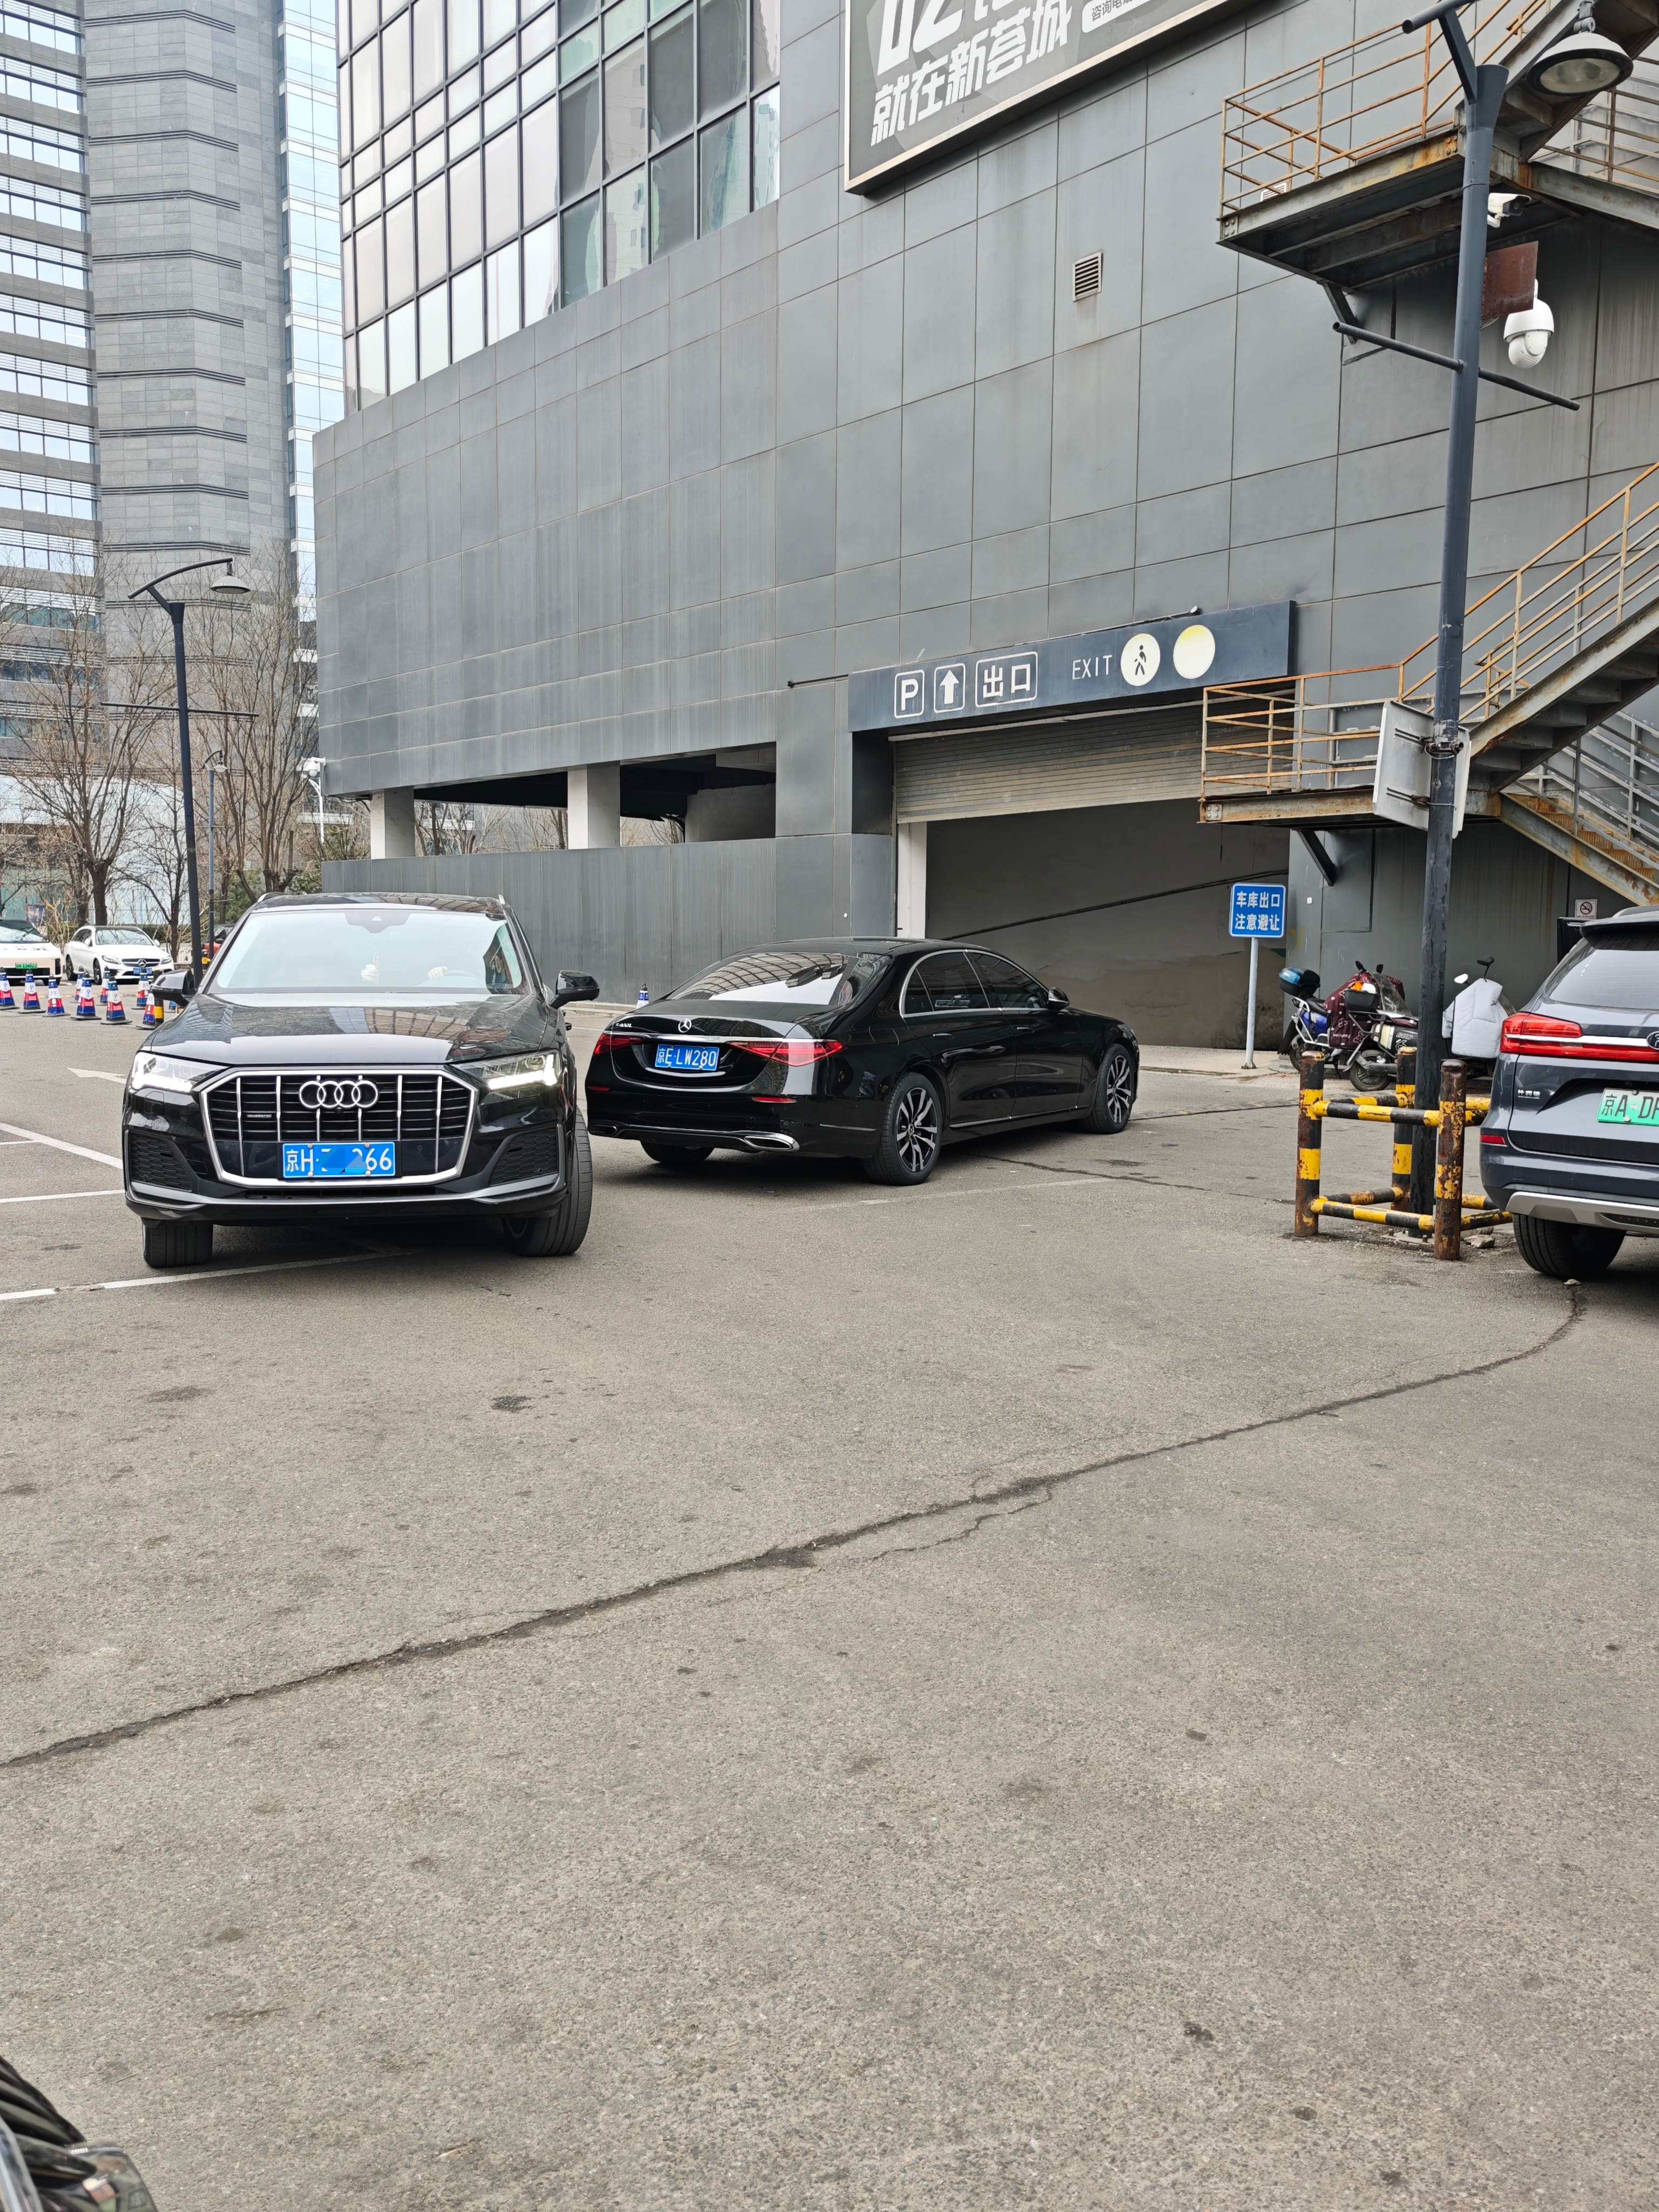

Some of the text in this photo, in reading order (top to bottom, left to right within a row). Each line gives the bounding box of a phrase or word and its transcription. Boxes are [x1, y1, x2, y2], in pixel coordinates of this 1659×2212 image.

[871, 0, 1073, 146] 就在新荟城
[901, 655, 1112, 711] P 出口 EXIT
[1236, 891, 1280, 908] 车库出口
[1235, 913, 1280, 930] 注意避让
[657, 1048, 717, 1067] 京E·LW280
